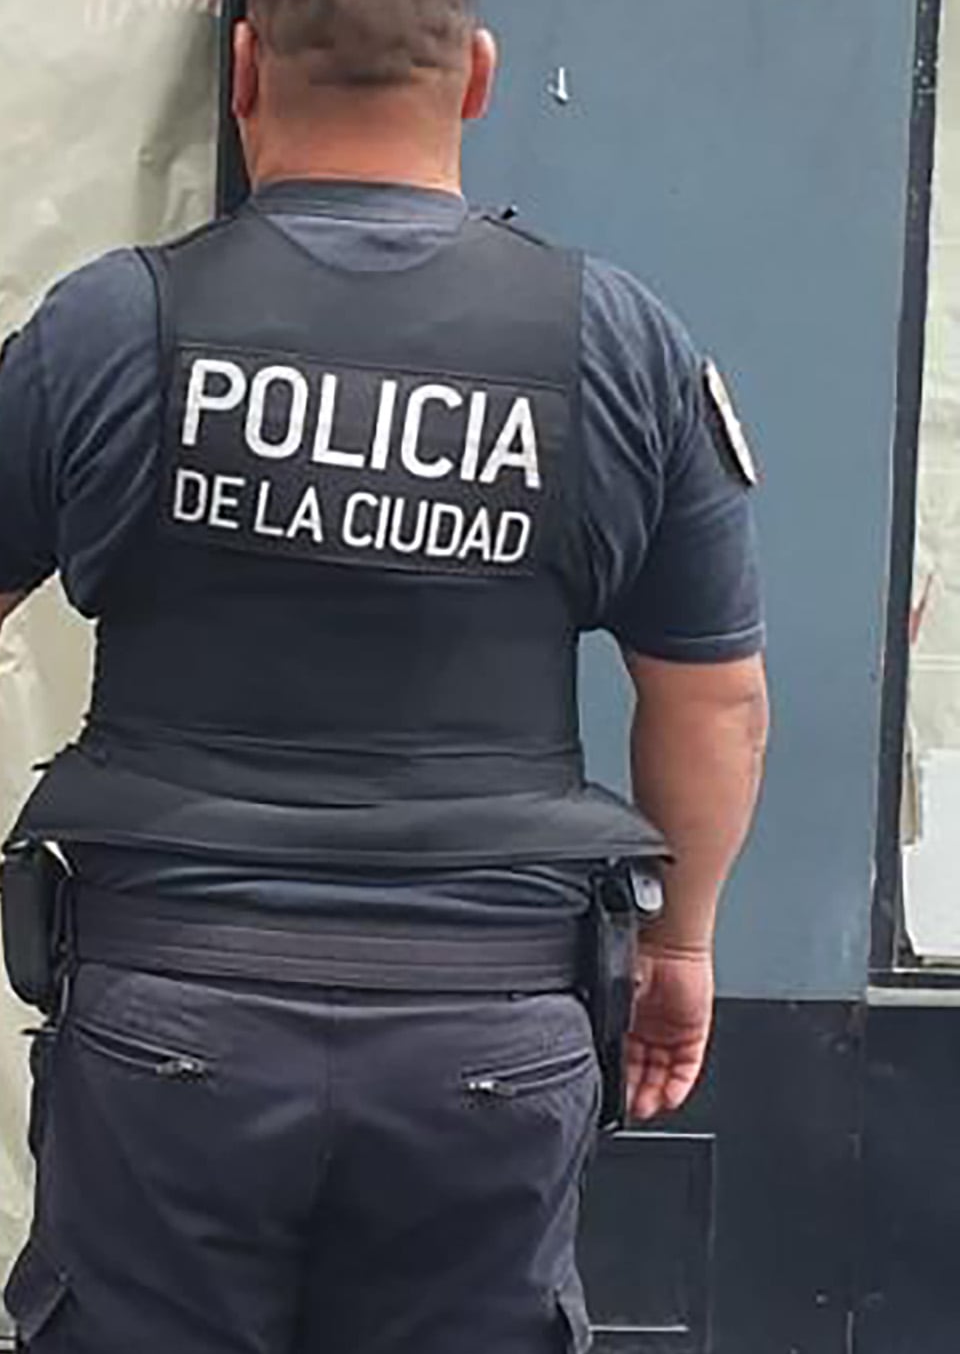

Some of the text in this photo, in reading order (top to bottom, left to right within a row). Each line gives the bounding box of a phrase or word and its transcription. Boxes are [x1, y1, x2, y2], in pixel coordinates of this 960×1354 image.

[182, 359, 541, 489] POLICIA
[173, 469, 531, 564] DE LA CIUDAD
